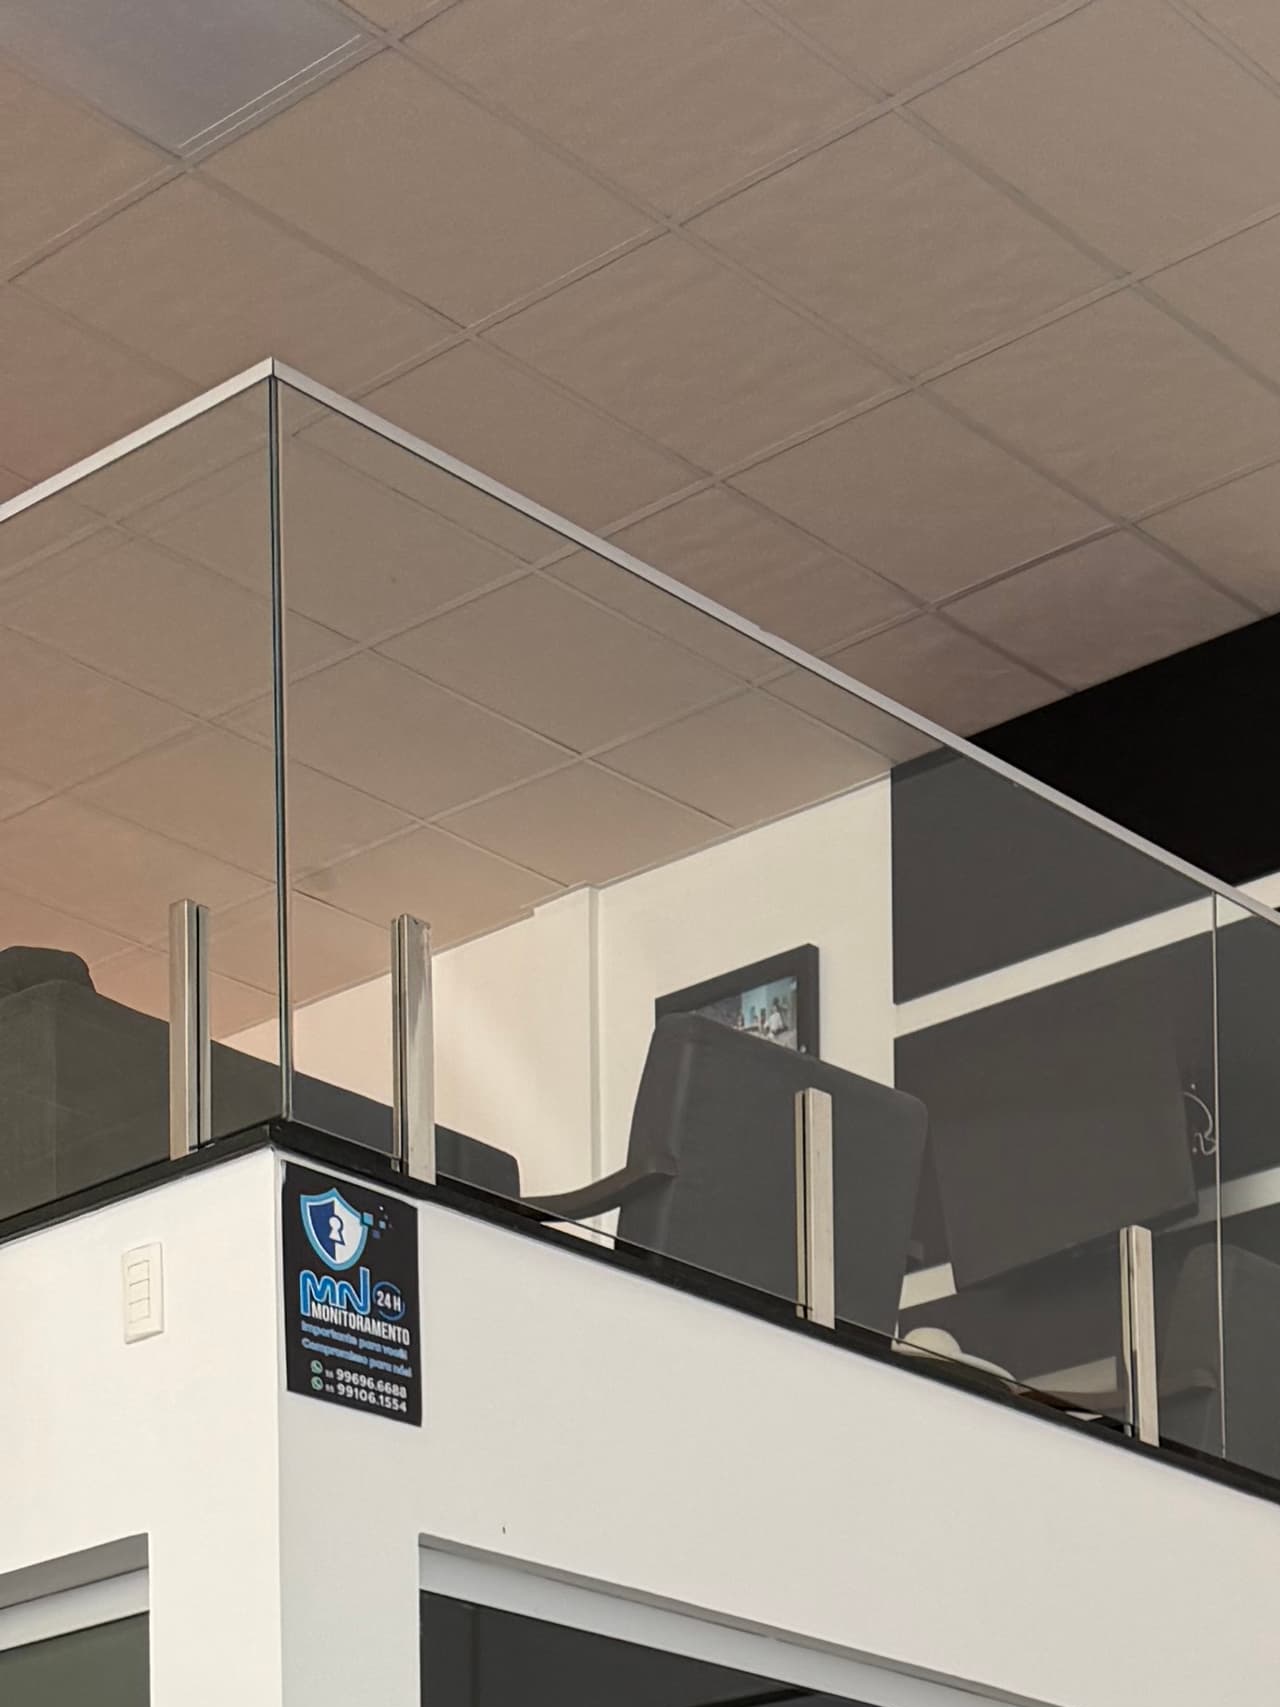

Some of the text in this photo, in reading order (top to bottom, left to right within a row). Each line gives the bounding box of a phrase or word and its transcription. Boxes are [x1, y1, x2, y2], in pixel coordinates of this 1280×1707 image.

[299, 1266, 370, 1317] MN
[377, 1290, 401, 1312] 24 H
[311, 1301, 410, 1346] MONITORAMENTO
[336, 1383, 408, 1413] 99106.1554
